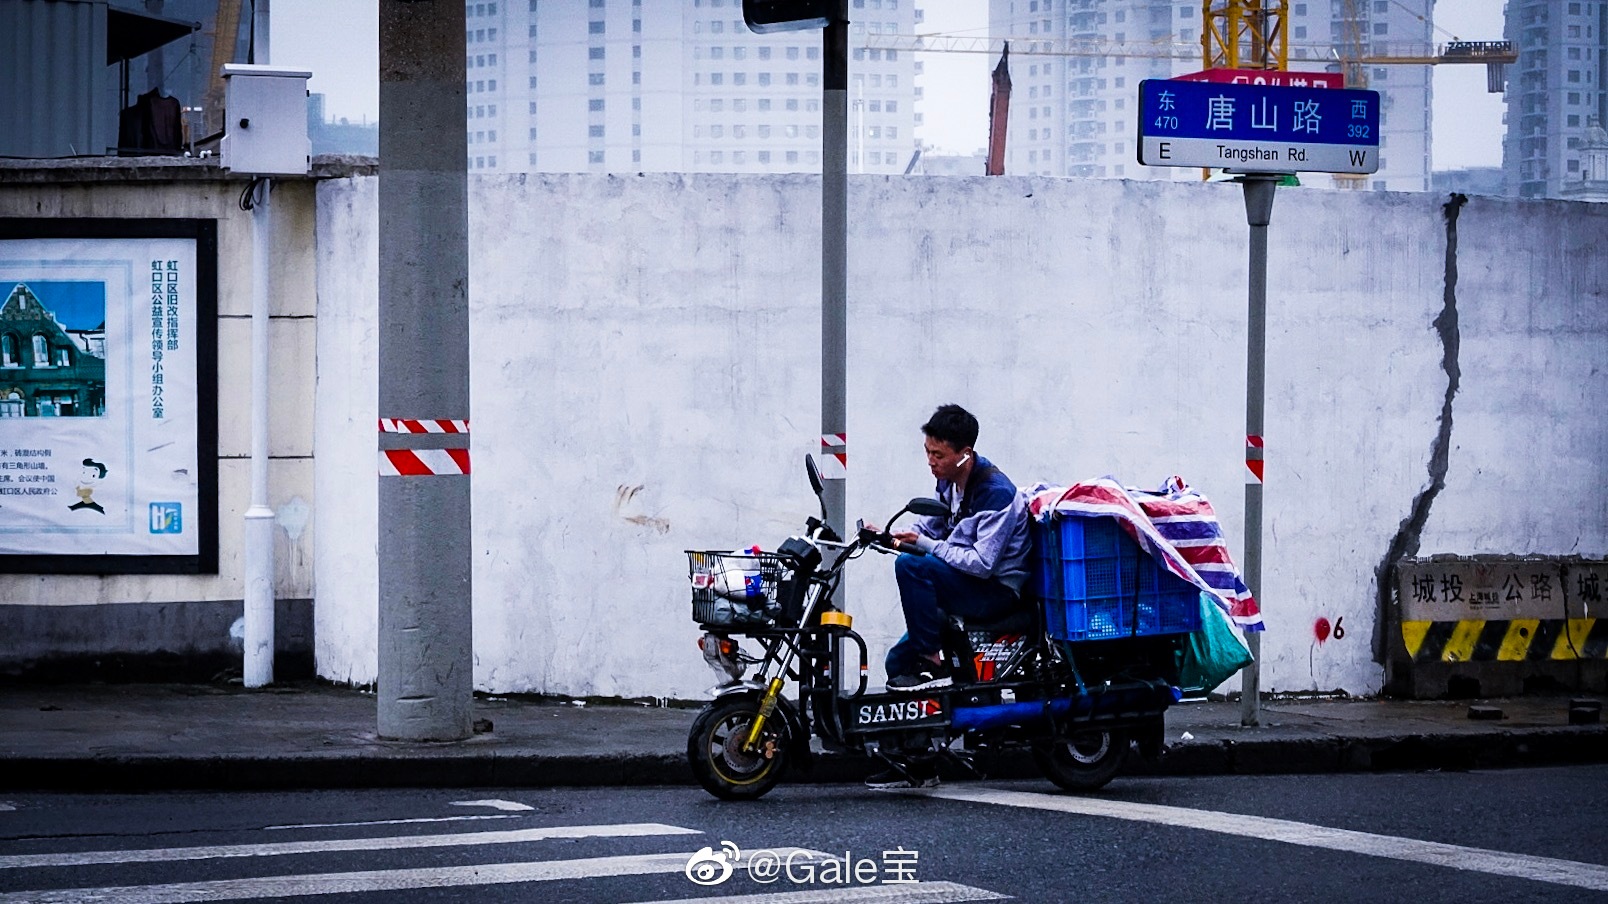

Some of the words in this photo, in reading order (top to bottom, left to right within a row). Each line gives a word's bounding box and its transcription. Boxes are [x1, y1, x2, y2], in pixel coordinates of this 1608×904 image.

[1158, 90, 1175, 111] 东
[1351, 99, 1368, 120] 西
[1154, 116, 1178, 130] 470
[1206, 94, 1322, 134] 唐山路
[1347, 124, 1370, 139] 392
[1159, 143, 1171, 159] E
[1217, 145, 1278, 162] Tangshan
[1288, 148, 1309, 162] Rd.
[1349, 150, 1367, 167] W
[166, 260, 179, 351] 虹口区旧改指挥部
[151, 260, 164, 419] 虹口区公益宣传领导小组办公室
[0, 461, 48, 470] 有三角形山墙。
[1412, 574, 1465, 603] 城投
[1502, 573, 1553, 601] 公路
[1577, 572, 1608, 602] 城
[1333, 616, 1345, 640] 6
[858, 700, 929, 724] SANSI
